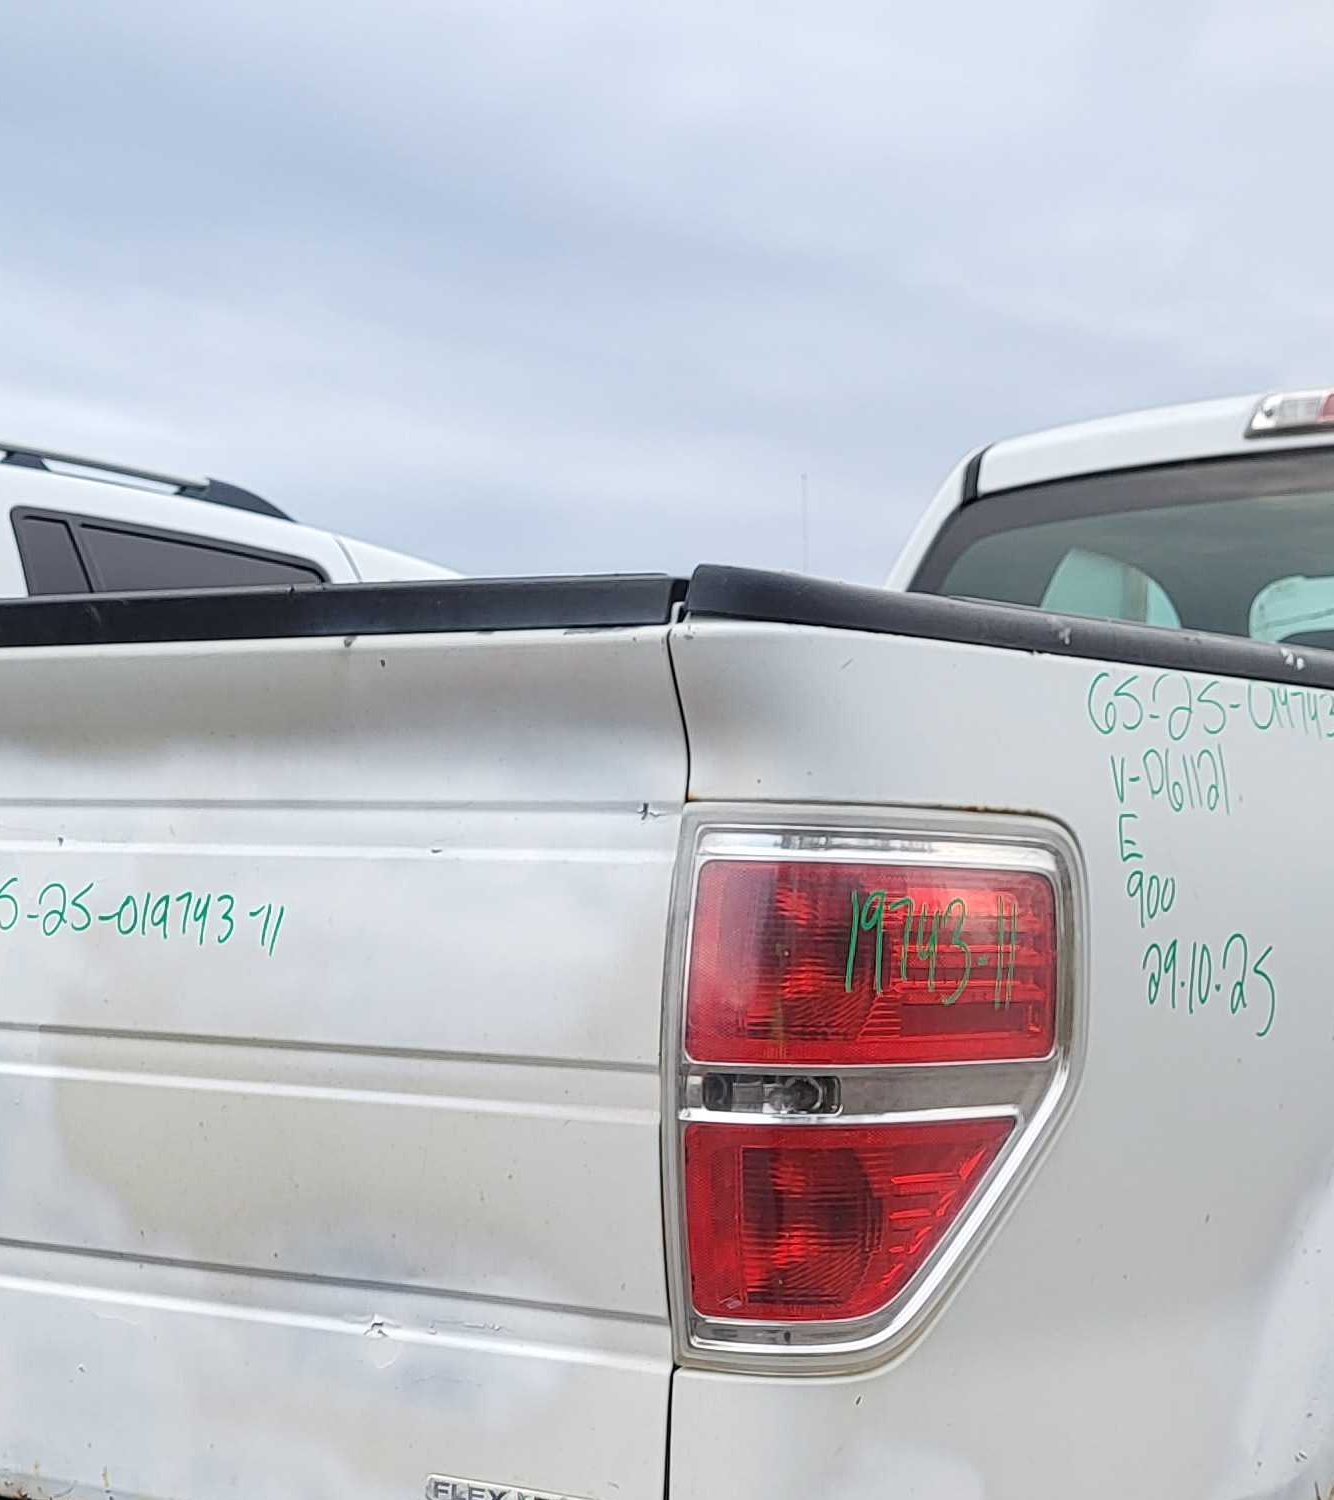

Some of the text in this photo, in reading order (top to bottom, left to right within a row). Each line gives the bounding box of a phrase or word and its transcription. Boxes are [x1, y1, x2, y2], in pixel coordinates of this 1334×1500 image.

[1119, 814, 1143, 862] E
[1127, 870, 1176, 929] 900
[1142, 933, 1276, 1038] 29.10.25
